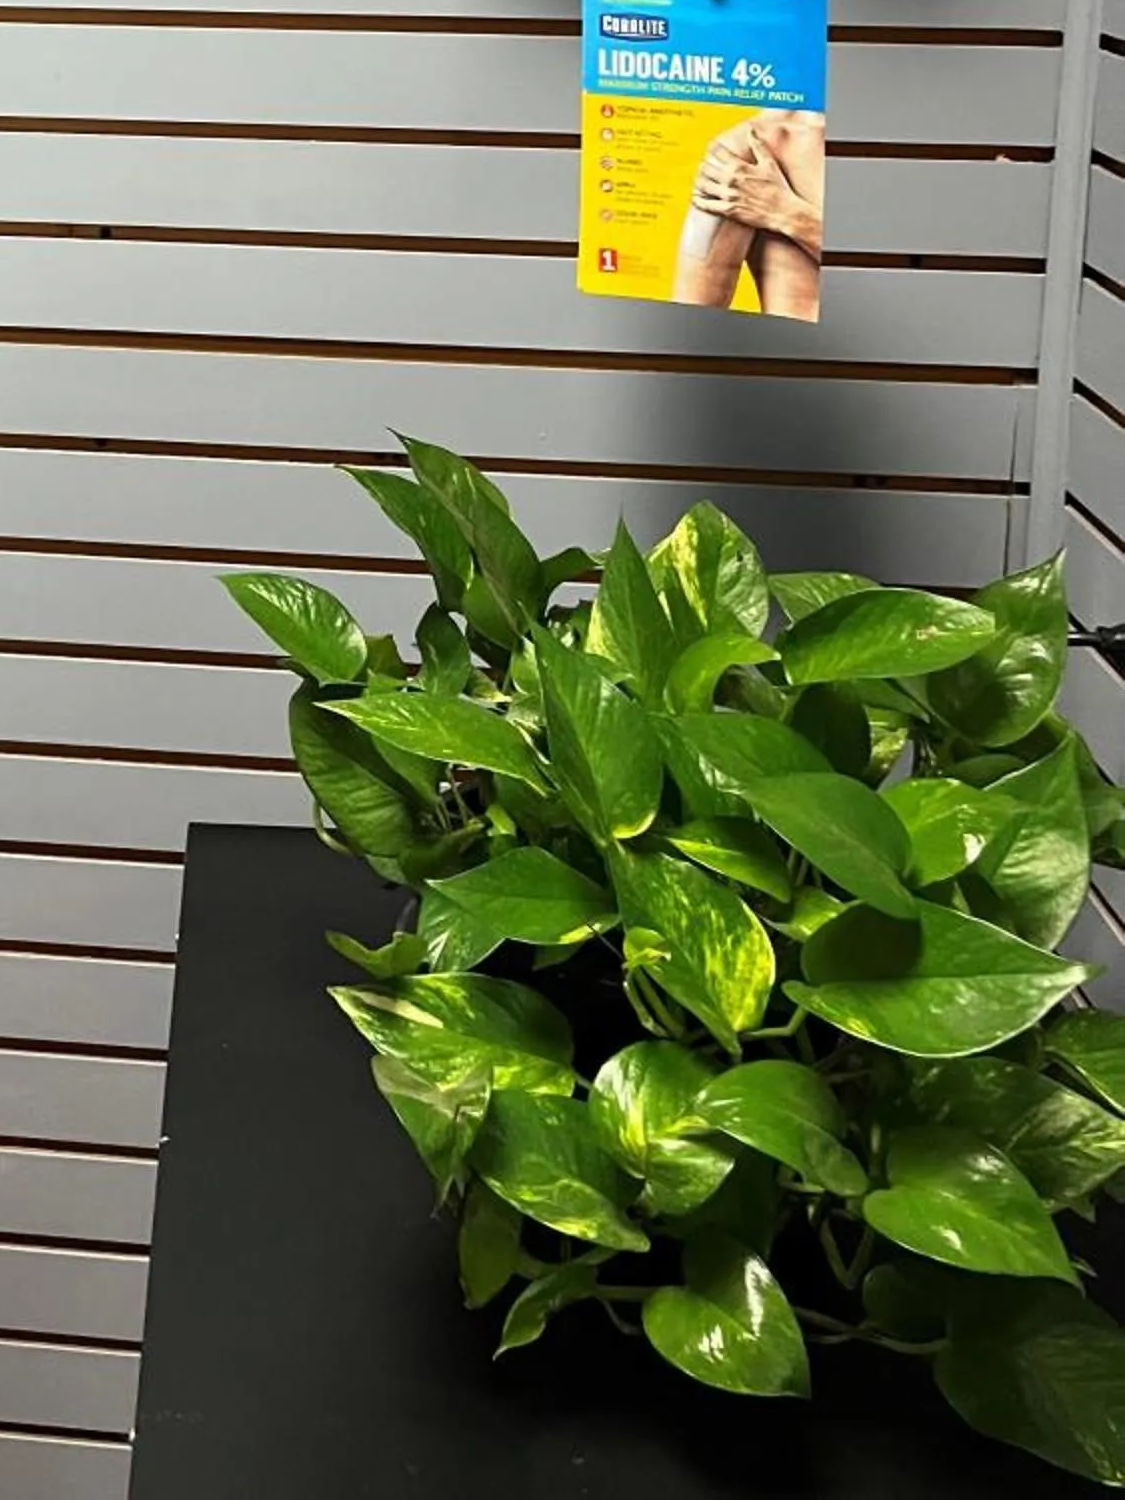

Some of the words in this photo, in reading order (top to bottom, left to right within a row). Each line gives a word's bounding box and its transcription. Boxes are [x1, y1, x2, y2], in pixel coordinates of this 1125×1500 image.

[603, 15, 666, 36] CORALITE
[599, 49, 724, 84] LIDOCAINE
[731, 58, 775, 87] 4%
[652, 83, 706, 95] STRENGTH
[708, 86, 732, 97] PAIN
[733, 88, 765, 100] RELIEF
[768, 91, 804, 103] PATCH
[602, 251, 616, 271] 1
